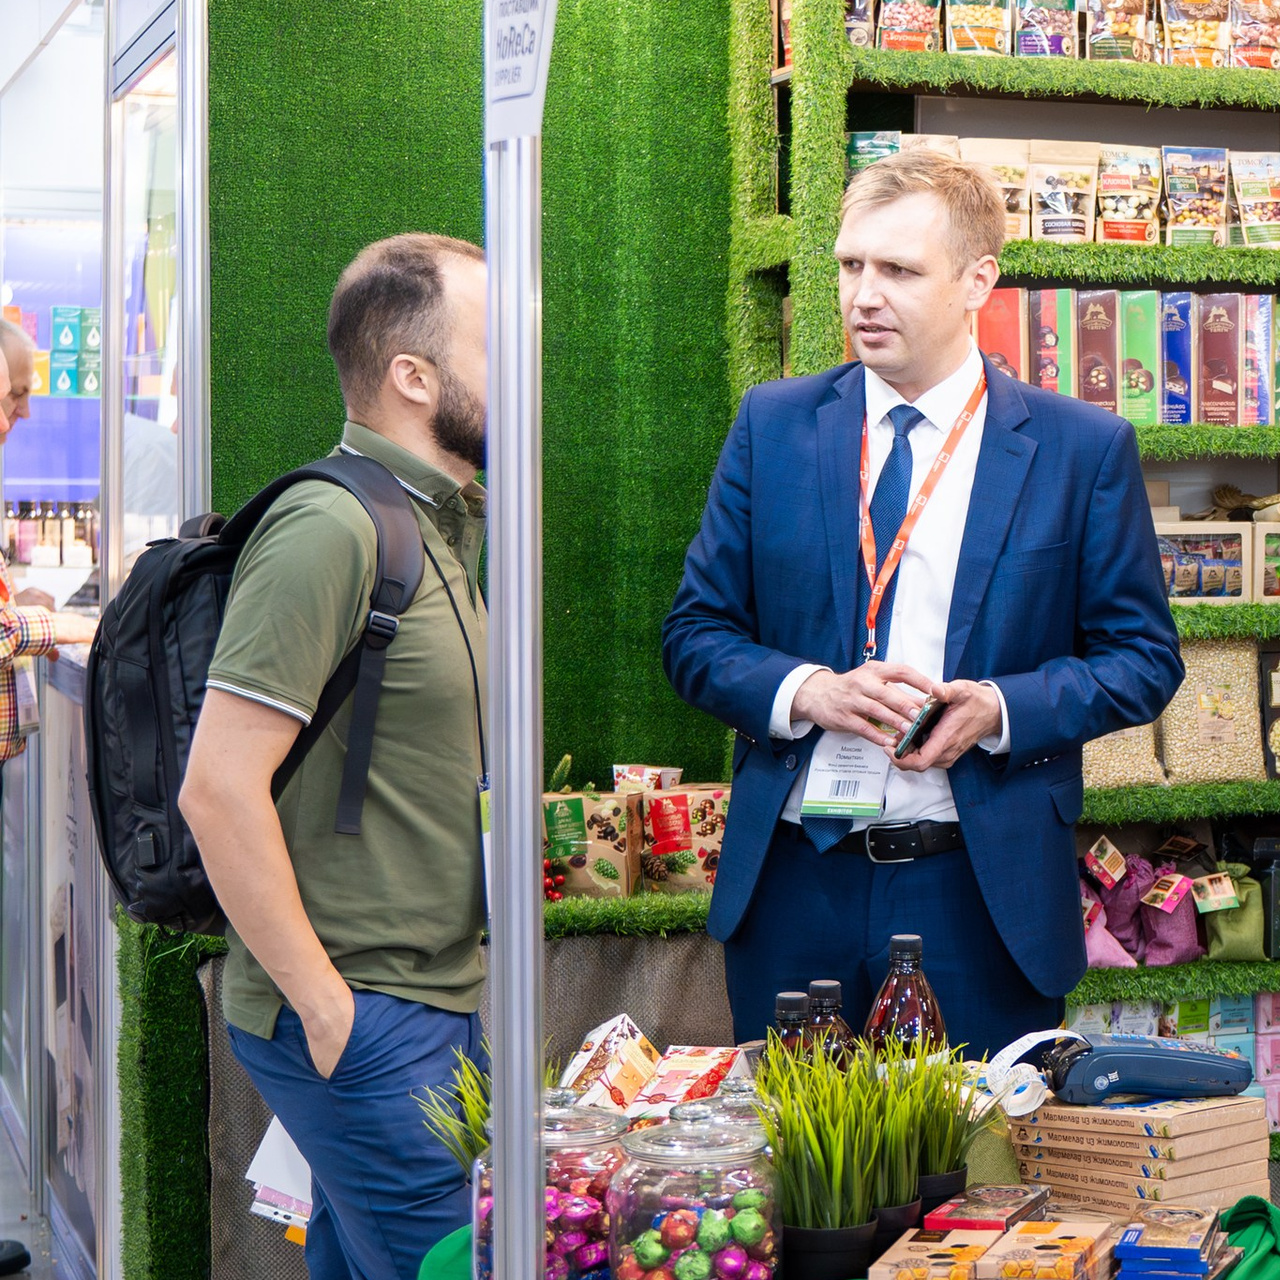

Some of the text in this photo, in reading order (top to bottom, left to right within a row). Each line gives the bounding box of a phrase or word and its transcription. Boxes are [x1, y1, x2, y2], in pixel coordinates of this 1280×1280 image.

[496, 22, 537, 62] HoReCa
[1102, 176, 1132, 187] КЛЮКВА
[1043, 1112, 1080, 1124] Мармелад
[1092, 1117, 1135, 1128] жимолости
[1047, 1132, 1140, 1149] Мармелад из жимолости
[1048, 1148, 1133, 1169] Мармелад из жимолости
[1046, 1168, 1129, 1189] Мармелад из жимолости
[1092, 1197, 1130, 1211] жимолости
